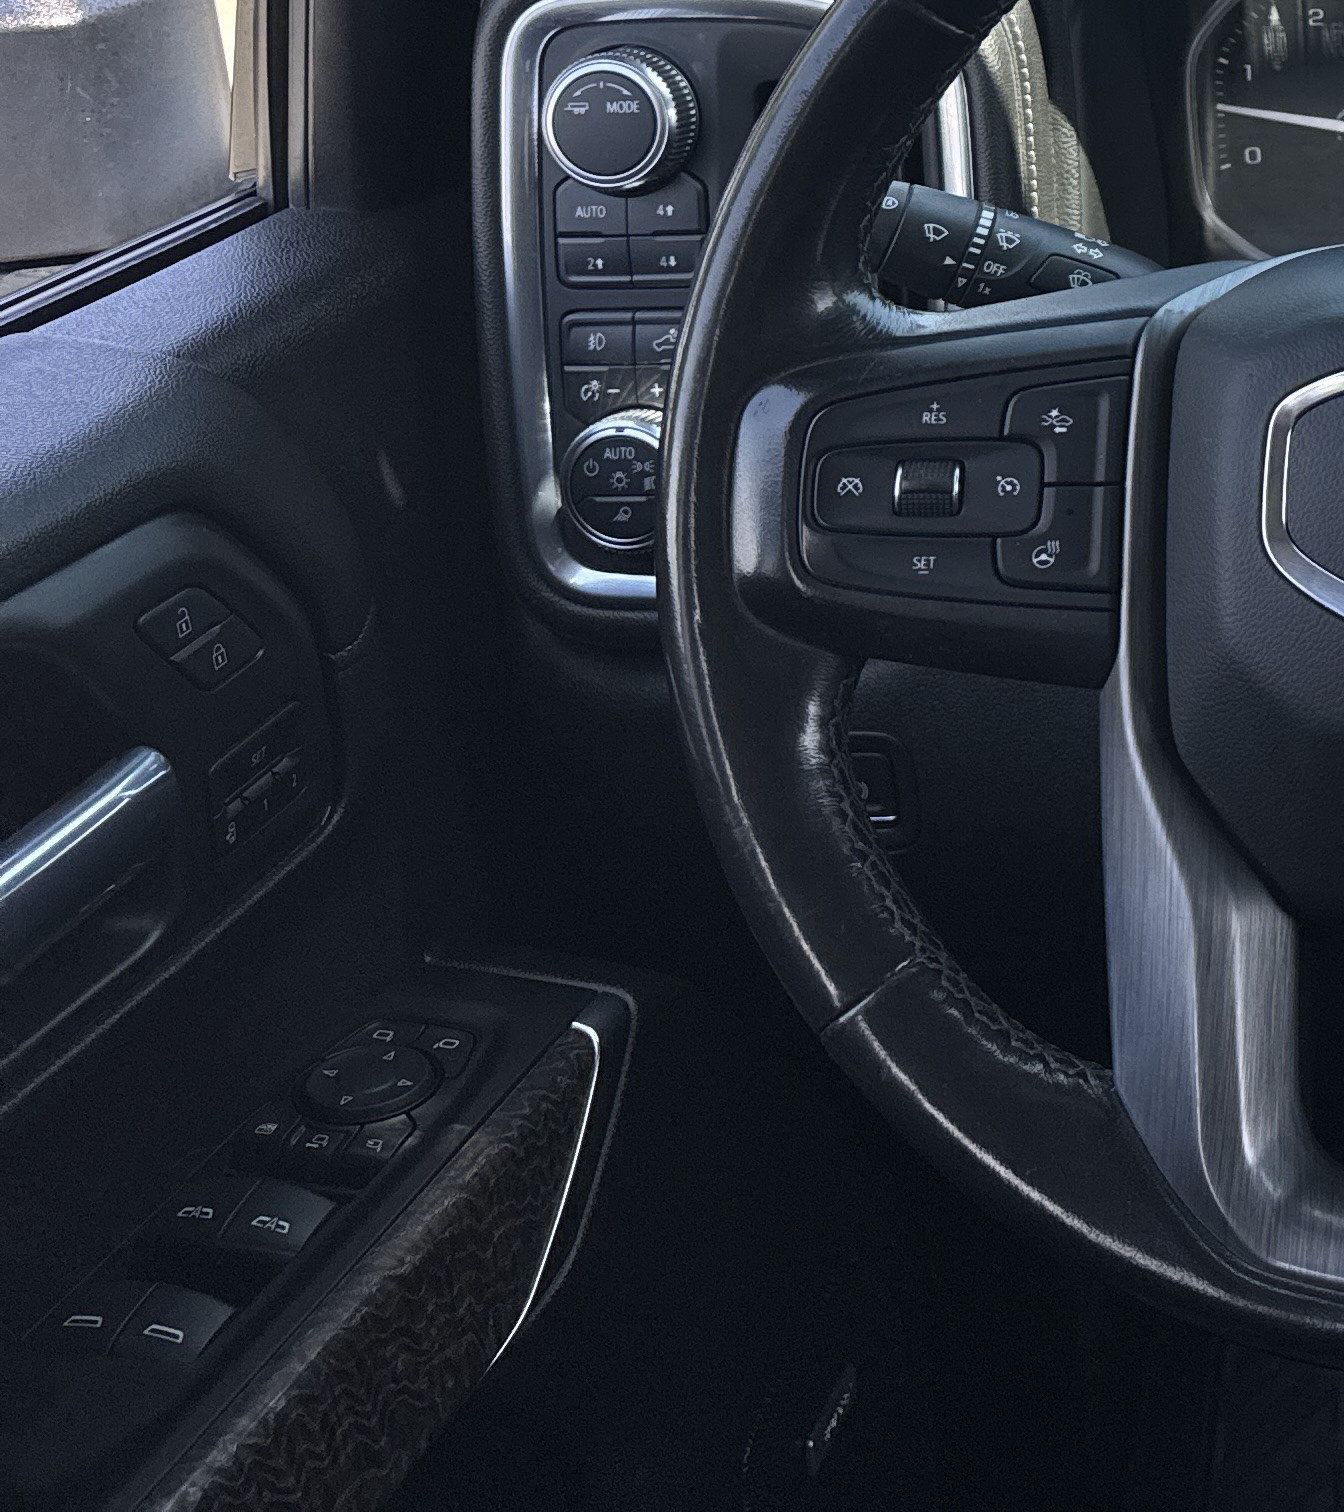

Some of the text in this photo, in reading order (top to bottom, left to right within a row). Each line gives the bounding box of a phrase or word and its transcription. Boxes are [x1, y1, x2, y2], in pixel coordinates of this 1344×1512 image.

[1308, 8, 1325, 27] 2
[1244, 64, 1252, 81] 1
[606, 100, 641, 114] MODE
[1243, 146, 1262, 165] 0
[575, 205, 607, 218] AUTO
[983, 260, 1007, 277] OFF
[977, 282, 992, 296] 1x
[922, 411, 947, 425] RES
[604, 446, 635, 460] AUTO
[912, 556, 937, 570] SET
